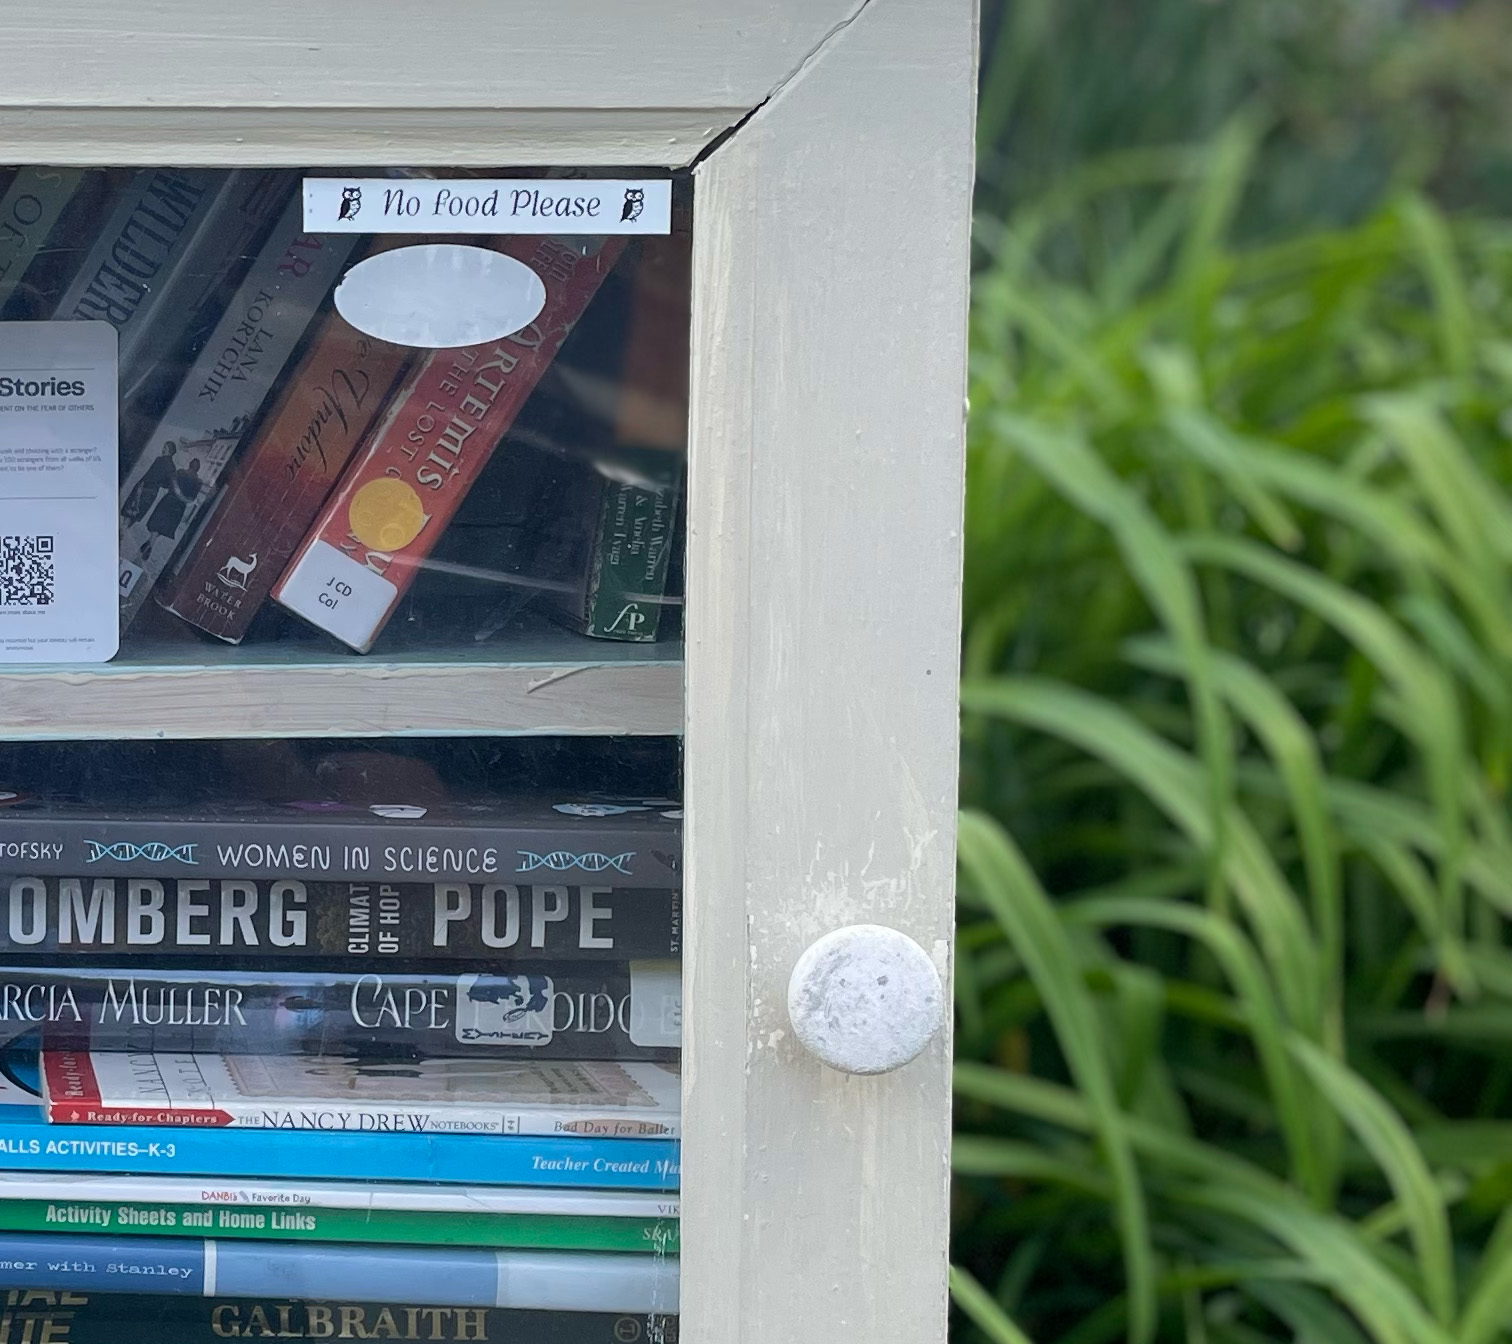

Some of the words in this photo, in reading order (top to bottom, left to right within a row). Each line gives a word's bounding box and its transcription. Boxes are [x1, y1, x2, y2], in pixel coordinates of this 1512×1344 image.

[383, 189, 421, 217] No
[509, 189, 601, 218] Please
[199, 289, 274, 403] KORTCHIK
[230, 327, 274, 384] LANA
[439, 349, 479, 396] THE
[400, 400, 446, 462] LOST
[204, 580, 244, 609] WATER
[318, 592, 339, 611] Col
[335, 581, 353, 598] CD
[196, 593, 237, 622] BROOK
[216, 842, 331, 871] WOMEN
[343, 845, 370, 871] IN
[383, 846, 499, 874] SCIENCE
[346, 882, 370, 954] CLIMAT
[377, 883, 400, 926] HOP
[432, 882, 615, 949] POPE
[377, 926, 400, 954] OF
[98, 975, 249, 1027] MULLER
[350, 973, 450, 1031] CAPE
[87, 1110, 218, 1125] Ready-for-Chapters
[237, 1114, 260, 1126] THE
[261, 1110, 351, 1130] NANCY
[358, 1112, 431, 1133] DREW
[430, 1119, 497, 1132] NOTEBOOKS
[553, 1120, 578, 1134] Bad
[583, 1121, 609, 1136] Day
[613, 1121, 634, 1136] for
[531, 1155, 590, 1172] Teacher
[593, 1157, 650, 1174] Created
[45, 1204, 111, 1227] Activity
[117, 1207, 177, 1227] Sheets
[182, 1208, 214, 1228] and
[218, 1210, 266, 1230] Home
[270, 1211, 317, 1231] Links
[251, 1191, 291, 1204] Favorite
[292, 1192, 311, 1205] Day
[657, 1204, 680, 1215] VIK
[47, 1260, 97, 1274] with
[105, 1262, 193, 1280] Stanley
[211, 1304, 489, 1341] GALBRAITH
